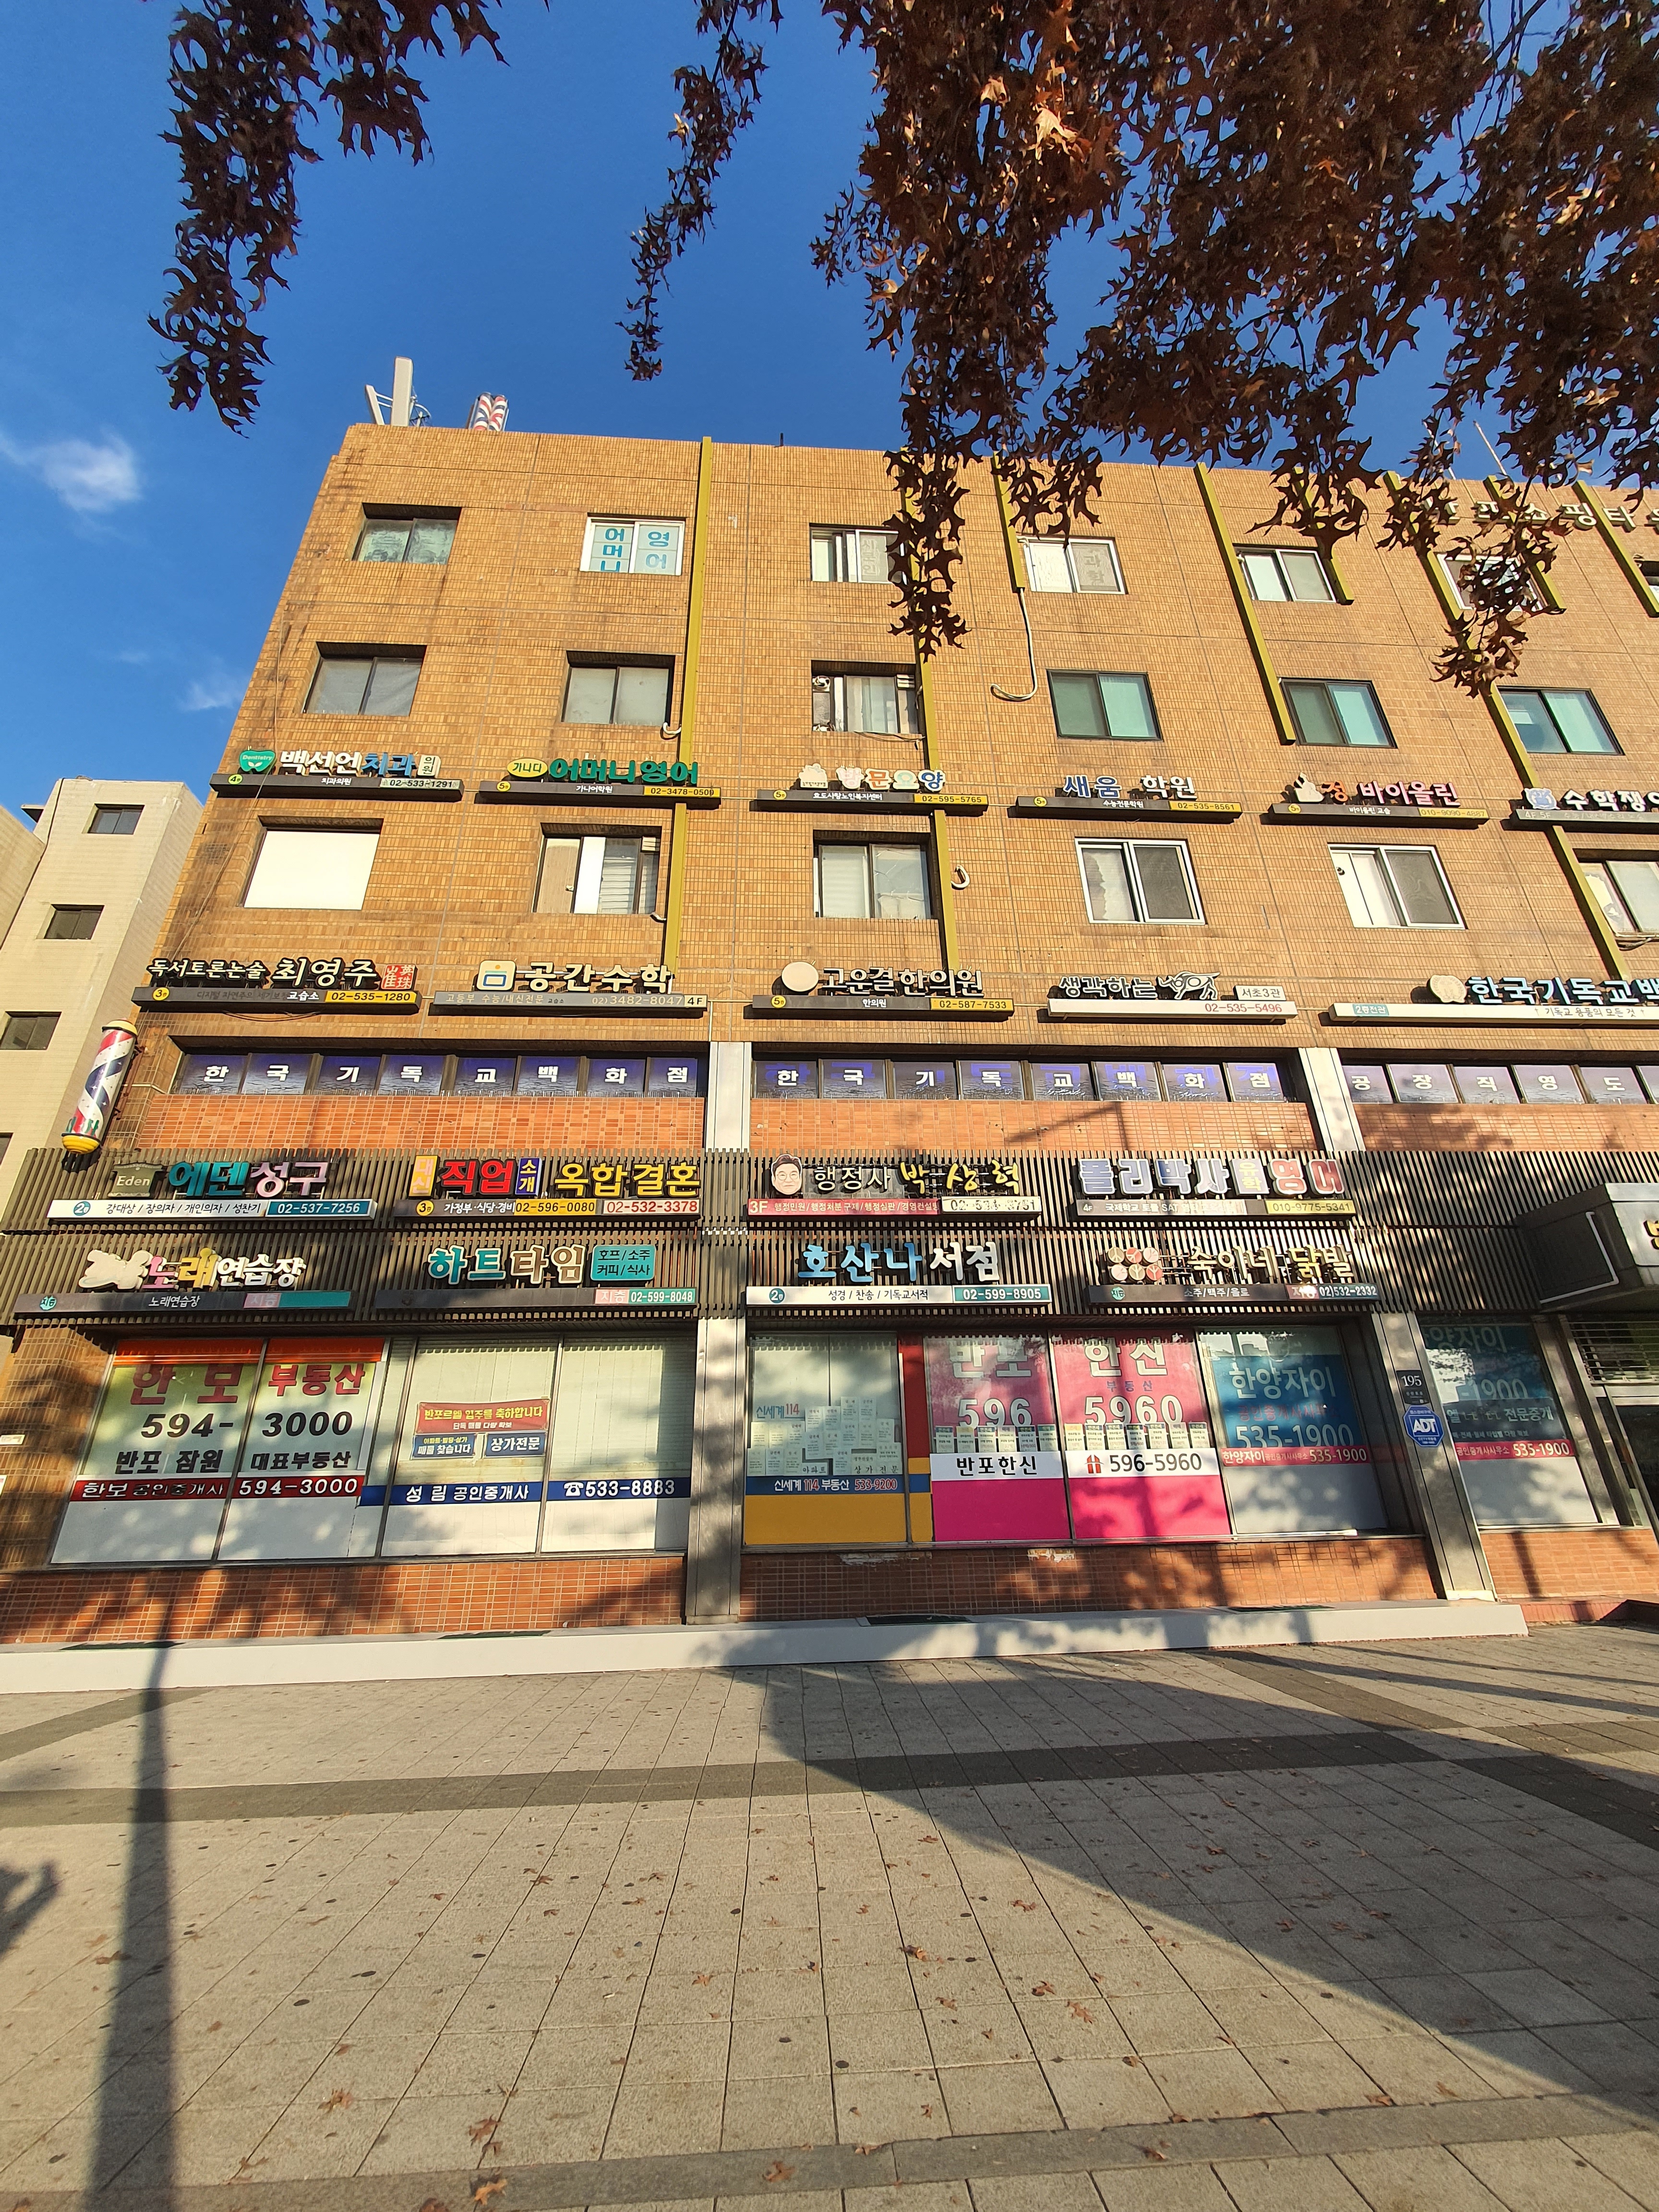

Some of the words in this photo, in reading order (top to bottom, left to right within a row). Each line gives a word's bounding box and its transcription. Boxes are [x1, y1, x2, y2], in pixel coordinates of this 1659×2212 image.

[601, 528, 625, 572] 어머니
[646, 531, 669, 569] 영어
[423, 757, 436, 775] 의원
[513, 763, 541, 772] 가나다
[389, 780, 453, 788] 02-533-1291
[1063, 775, 1122, 798] 새움
[1140, 775, 1197, 799] 학원
[650, 788, 715, 796] 02-3478-0509
[813, 792, 882, 801] 효도사랑노인복지센터
[1323, 780, 1347, 804] 정
[1360, 781, 1461, 807] 바이올린
[922, 795, 982, 803] 02-595-5765
[1103, 800, 1144, 808] 수능전문학원
[1178, 802, 1235, 811] 02-535-8561
[1421, 809, 1485, 817] 010-9090-4887
[1525, 811, 1536, 819] 4F
[1540, 812, 1551, 820] 5F
[148, 959, 267, 979] 독서토론논술
[272, 958, 377, 986] 최영주
[528, 962, 673, 993] 공간수학
[1059, 976, 1157, 999] 생각하는
[1241, 988, 1280, 998] 서초3관
[287, 991, 319, 1000] 교습소
[332, 992, 411, 1001] 02-535-1280
[481, 994, 544, 1003] 수능/내신전문
[592, 996, 682, 1005] 02)3482-8047
[687, 998, 703, 1006] 4F
[862, 998, 887, 1008] 한의원
[939, 1000, 1007, 1009] 02-587-7533
[1205, 1003, 1283, 1012] 02-535-5496
[1546, 1007, 1573, 1017] 기독교
[1575, 1007, 1603, 1017] 용품의
[1606, 1007, 1624, 1017] 모든
[1626, 1007, 1636, 1018] 것
[116, 1175, 150, 1187] Eden
[169, 1161, 327, 1198] 에덴성구
[441, 1160, 514, 1194] 직업
[518, 1160, 537, 1192] 소개
[554, 1163, 701, 1197] 옥합결혼
[814, 1166, 891, 1191] 행정사
[1079, 1158, 1229, 1194] 폴리박사
[1238, 1162, 1262, 1191] 유학
[1268, 1158, 1344, 1194] 영어
[106, 1203, 135, 1214] 강대상
[146, 1203, 174, 1213] 장의자
[184, 1203, 223, 1214] 개인의자
[232, 1202, 260, 1214] 성찬기
[277, 1202, 360, 1214] 02-537-7256
[444, 1202, 472, 1214] 가정부
[516, 1202, 595, 1213] 02-596-0080
[607, 1201, 697, 1213] 02-532-3378
[750, 1201, 768, 1214] 3F
[1161, 1202, 1178, 1212] SAT
[1273, 1202, 1351, 1212] 010-9775-5341
[144, 1248, 305, 1288] 노래연습장
[428, 1245, 586, 1284] 하트타임
[1189, 1246, 1278, 1280] 숙이네
[1290, 1245, 1354, 1280] 닭발
[601, 1290, 625, 1303] 지층
[630, 1290, 693, 1302] 02-599-8048
[828, 1290, 845, 1301] 성경
[855, 1290, 874, 1300] 찬송
[884, 1289, 928, 1300] 기독교서적
[962, 1288, 1041, 1300] 02-599-8905
[1319, 1286, 1377, 1298] 02)532-2332
[148, 1296, 201, 1307] 노래연습장
[950, 1338, 1032, 1378] 반포
[1084, 1337, 1169, 1377] 한신
[131, 1364, 239, 1405] 한보
[269, 1364, 365, 1396] 부동산
[1106, 1380, 1153, 1392] 부동산
[1229, 1362, 1336, 1399] 한양자이
[1401, 1375, 1422, 1386] 195
[424, 1409, 462, 1420] 반포르엘
[465, 1408, 493, 1420] 입주를
[496, 1406, 543, 1419] 축하합니다
[1413, 1419, 1435, 1433] ADT
[417, 1445, 435, 1455] 매물
[437, 1444, 471, 1455] 찾습니다
[490, 1437, 541, 1452] 상가전문
[1512, 1442, 1570, 1456] 535-1900
[115, 1451, 162, 1474] 반포
[176, 1450, 224, 1473] 잠원
[251, 1451, 351, 1471] 대표부동산
[1223, 1450, 1266, 1464] 한양자이
[1309, 1449, 1367, 1462] 535-1900
[803, 1466, 827, 1474] 아파트
[956, 1456, 1038, 1477] 반포한신
[1109, 1453, 1202, 1472] 596-5960
[82, 1482, 126, 1498] 한보
[240, 1479, 357, 1495] 594-3000
[774, 1479, 802, 1491] 신세계
[804, 1479, 819, 1491] 114
[821, 1479, 850, 1491] 부동산
[854, 1478, 898, 1491] 533-9200
[454, 1485, 529, 1501] 공인중개사
